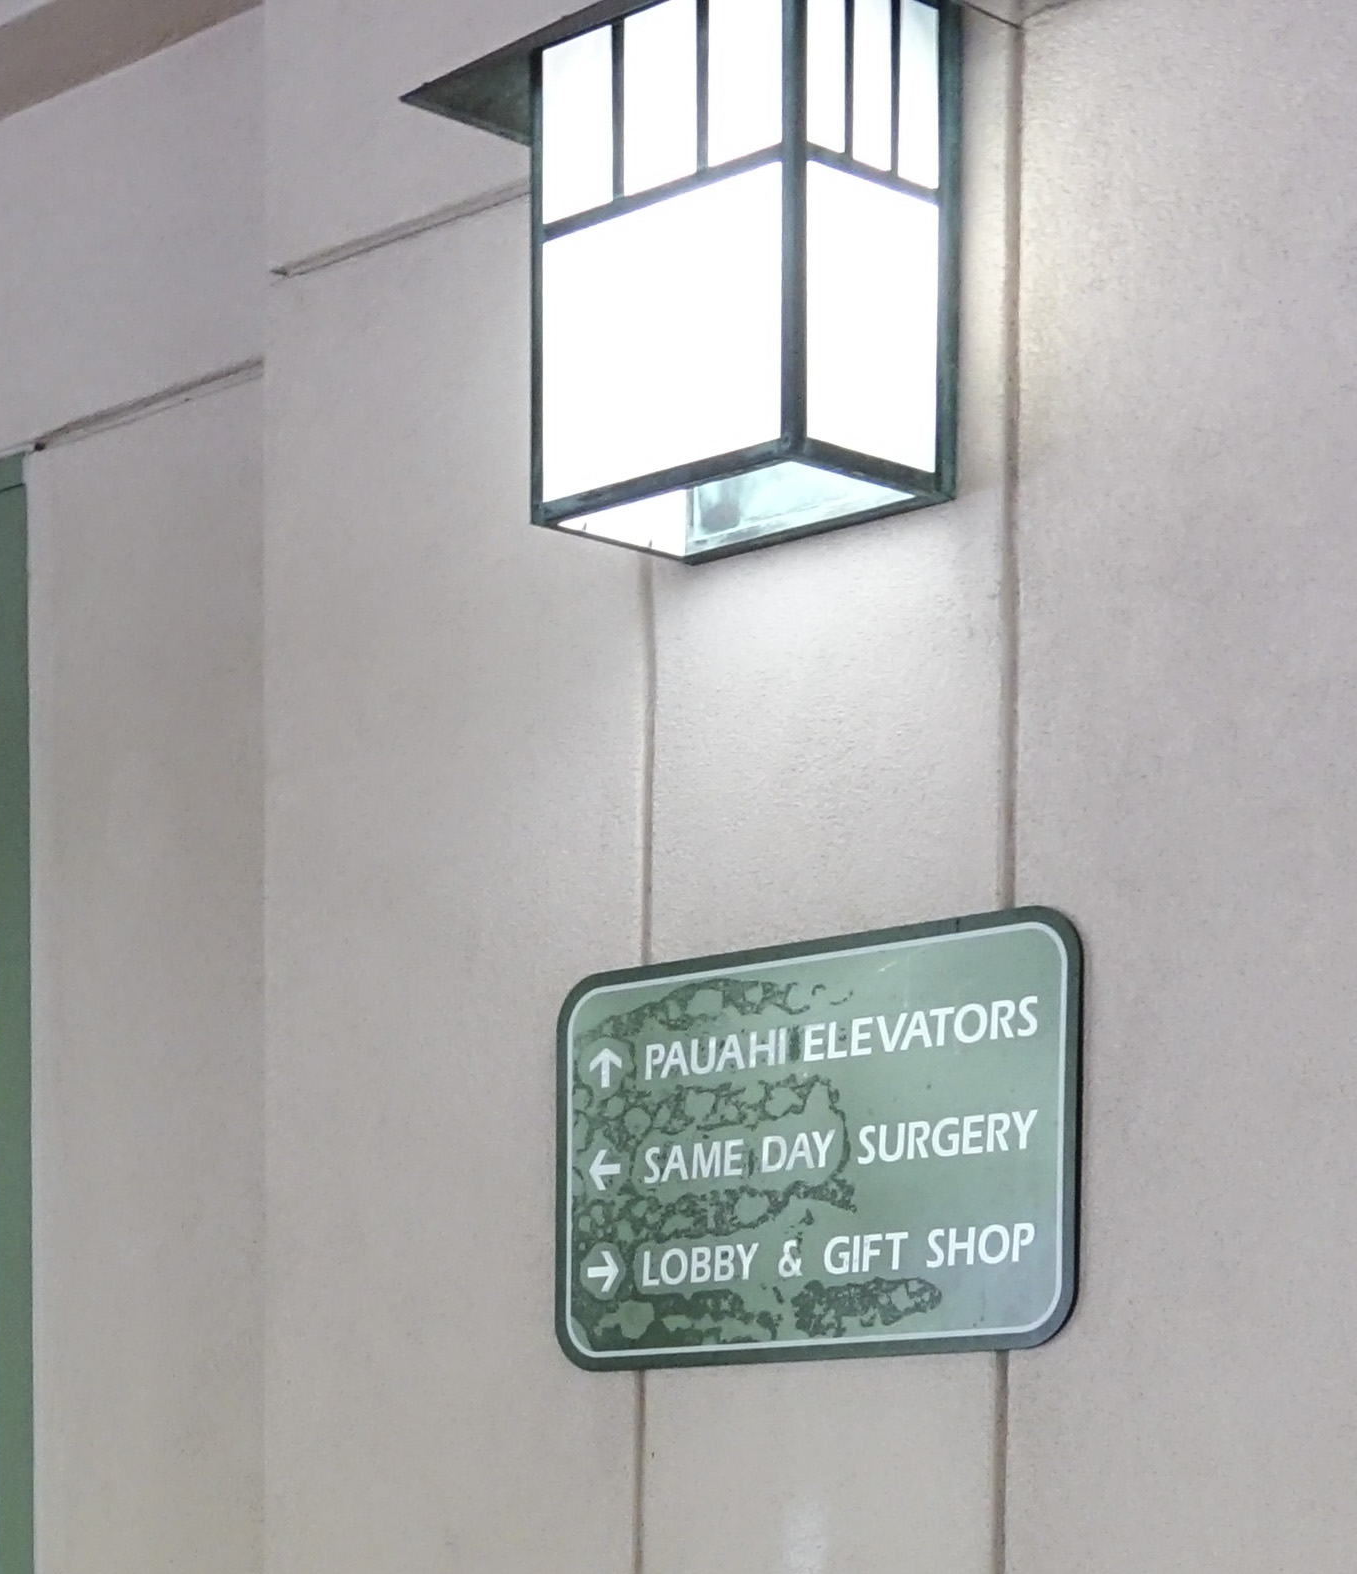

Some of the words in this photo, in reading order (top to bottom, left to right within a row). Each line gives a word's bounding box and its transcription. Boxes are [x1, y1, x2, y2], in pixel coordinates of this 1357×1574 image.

[644, 1029, 786, 1080] PAUAHI
[803, 996, 1038, 1062] ELEVATORS
[644, 1139, 743, 1184] SAME
[761, 1130, 836, 1172] DAY
[857, 1109, 1038, 1165] SURGERY
[642, 1242, 759, 1287] LOBBY
[778, 1239, 803, 1277] &
[824, 1231, 909, 1275] GIFT
[926, 1222, 1036, 1268] SHOP
